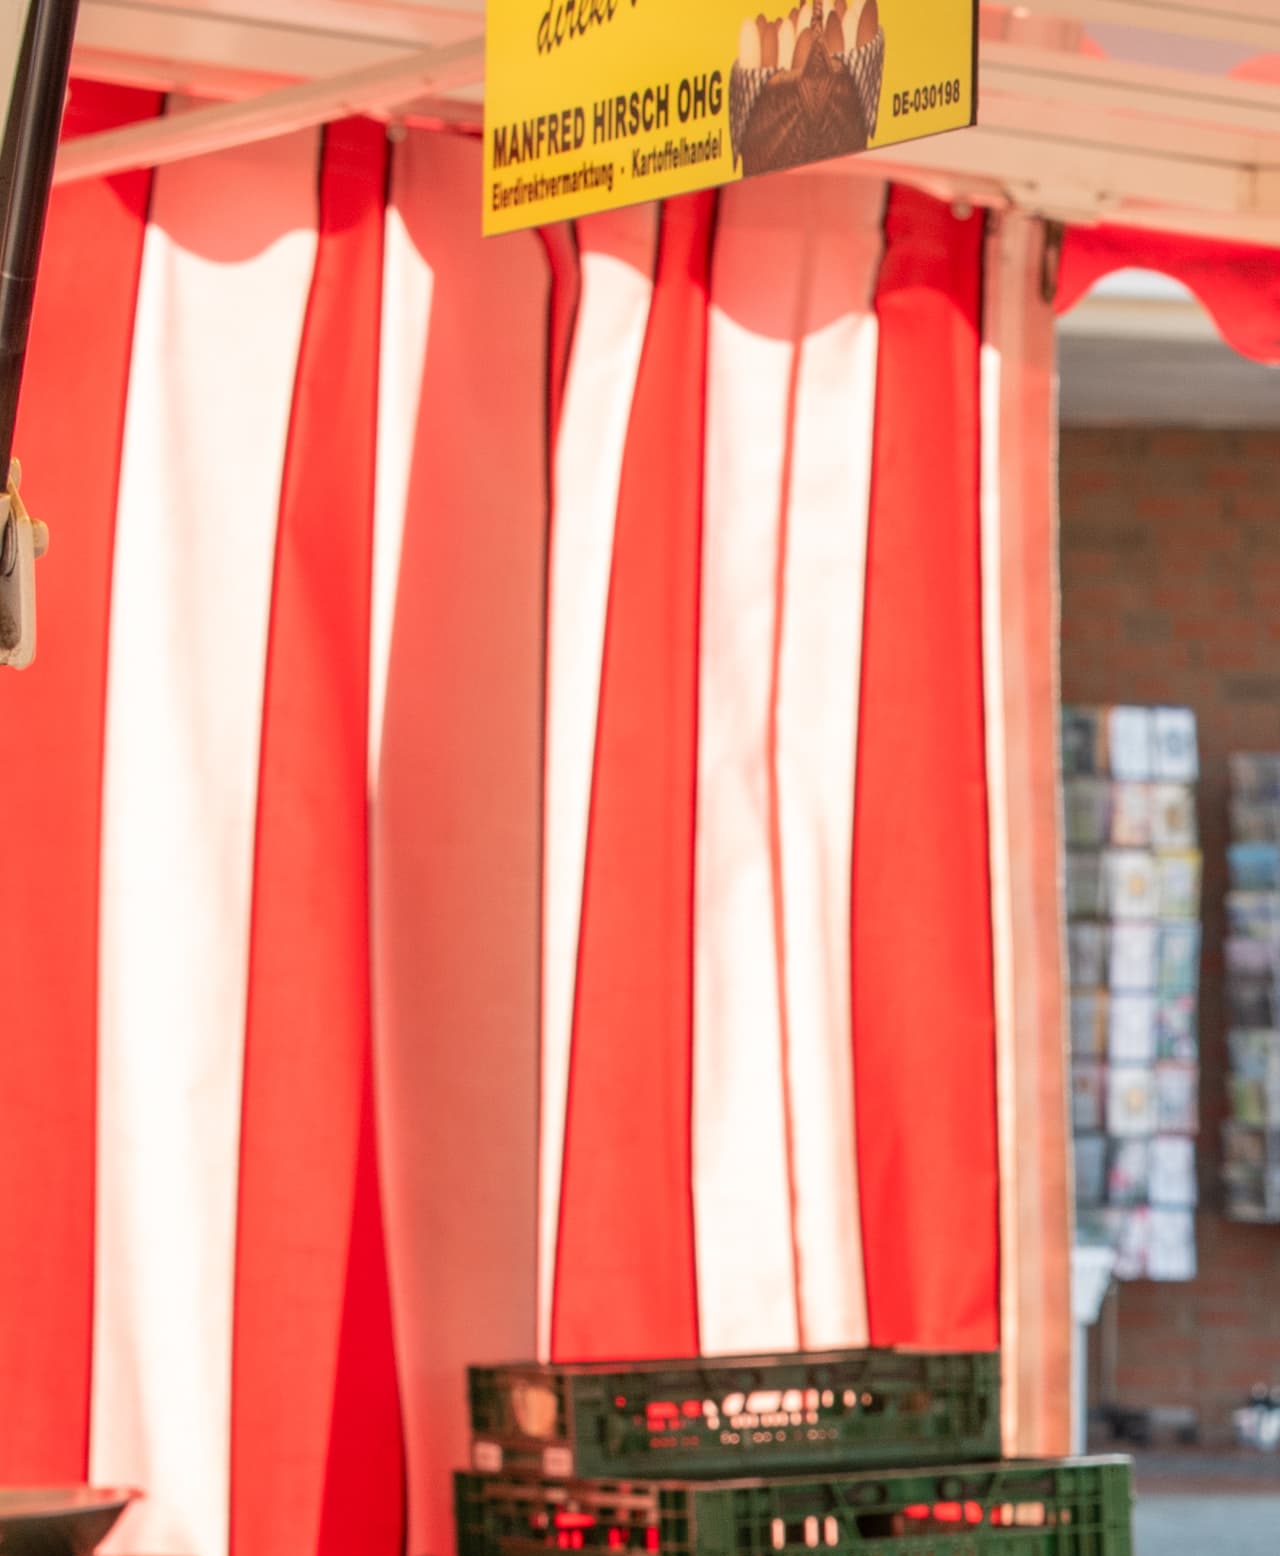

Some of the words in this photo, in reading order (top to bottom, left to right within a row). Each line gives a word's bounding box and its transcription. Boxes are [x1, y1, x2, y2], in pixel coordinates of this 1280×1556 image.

[493, 106, 585, 170] MANFRED
[593, 83, 669, 145] HIRSCH
[677, 70, 722, 124] OHG
[893, 78, 960, 118] DE-030198
[492, 161, 614, 212] Eierdirektvermarktung
[631, 128, 722, 179] Kartoffelhandel
